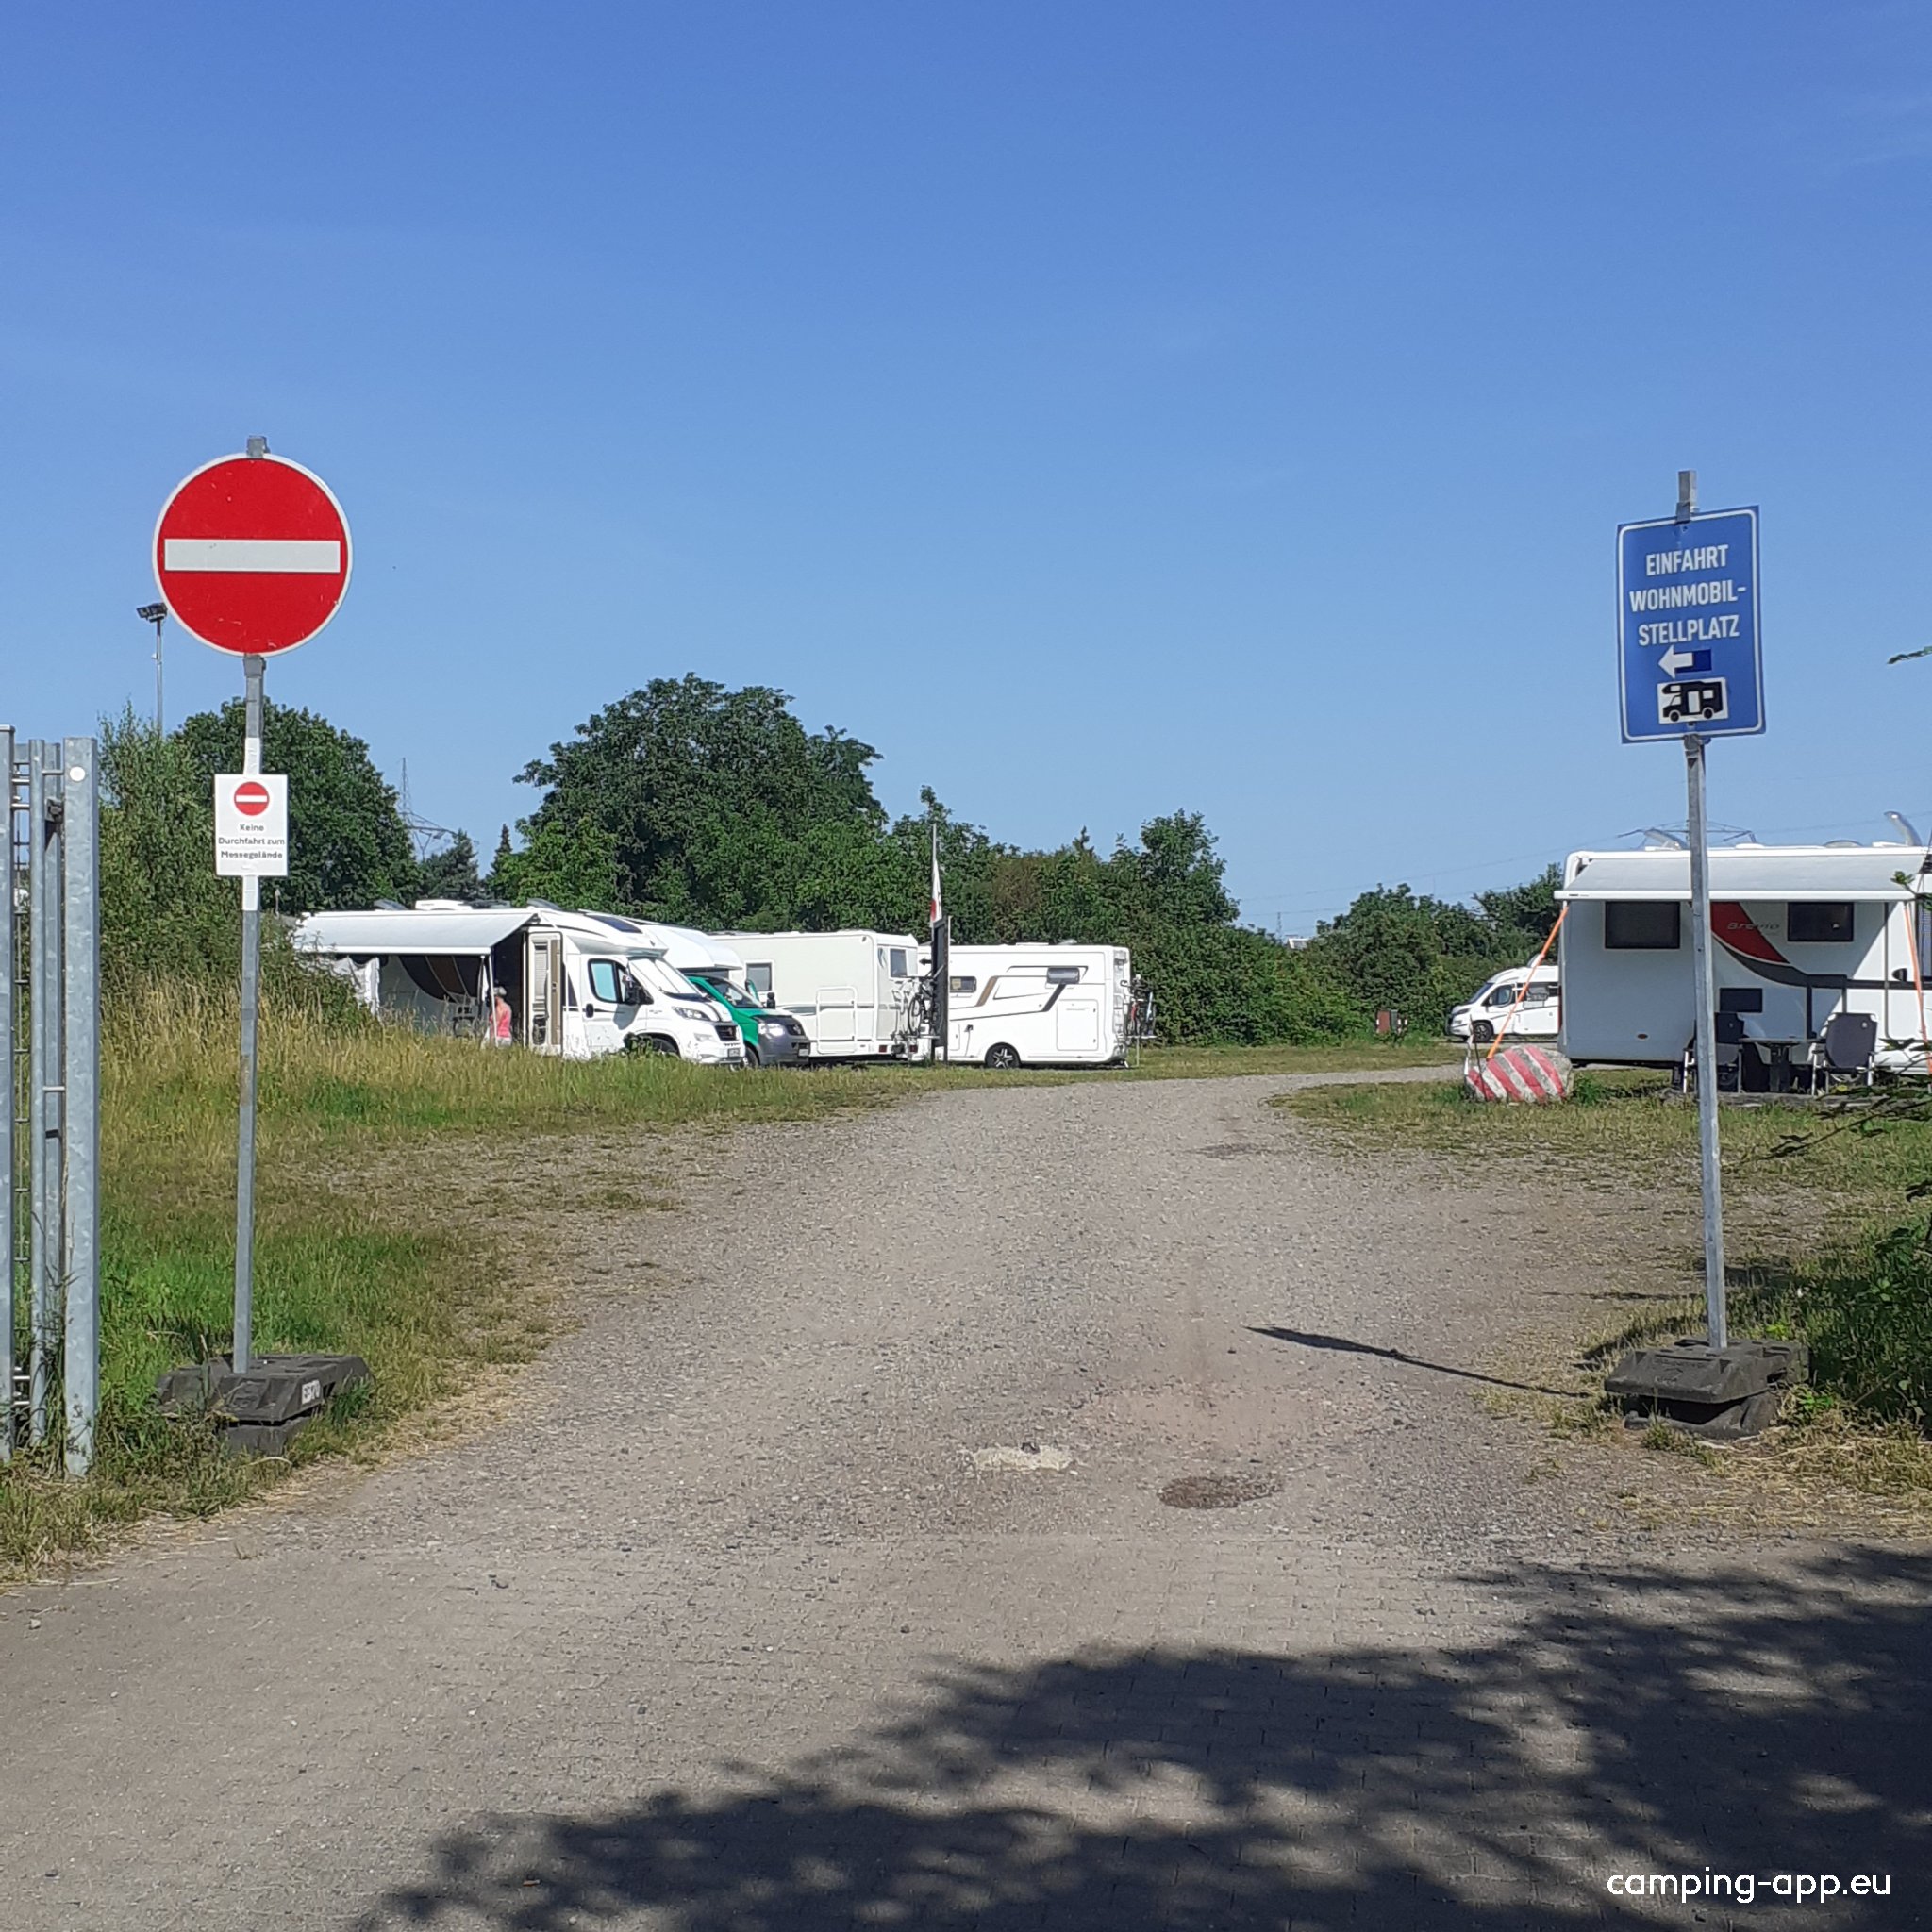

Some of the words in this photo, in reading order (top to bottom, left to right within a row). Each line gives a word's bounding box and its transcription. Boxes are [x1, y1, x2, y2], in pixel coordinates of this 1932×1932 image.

[1645, 544, 1729, 576] EINFAHRT
[1629, 579, 1747, 612] WOHNMOBIL-
[1638, 614, 1740, 646] STELLPLATZ
[240, 824, 265, 832] Keine
[218, 837, 266, 845] Durchfahrt
[221, 850, 283, 860] Messegelände
